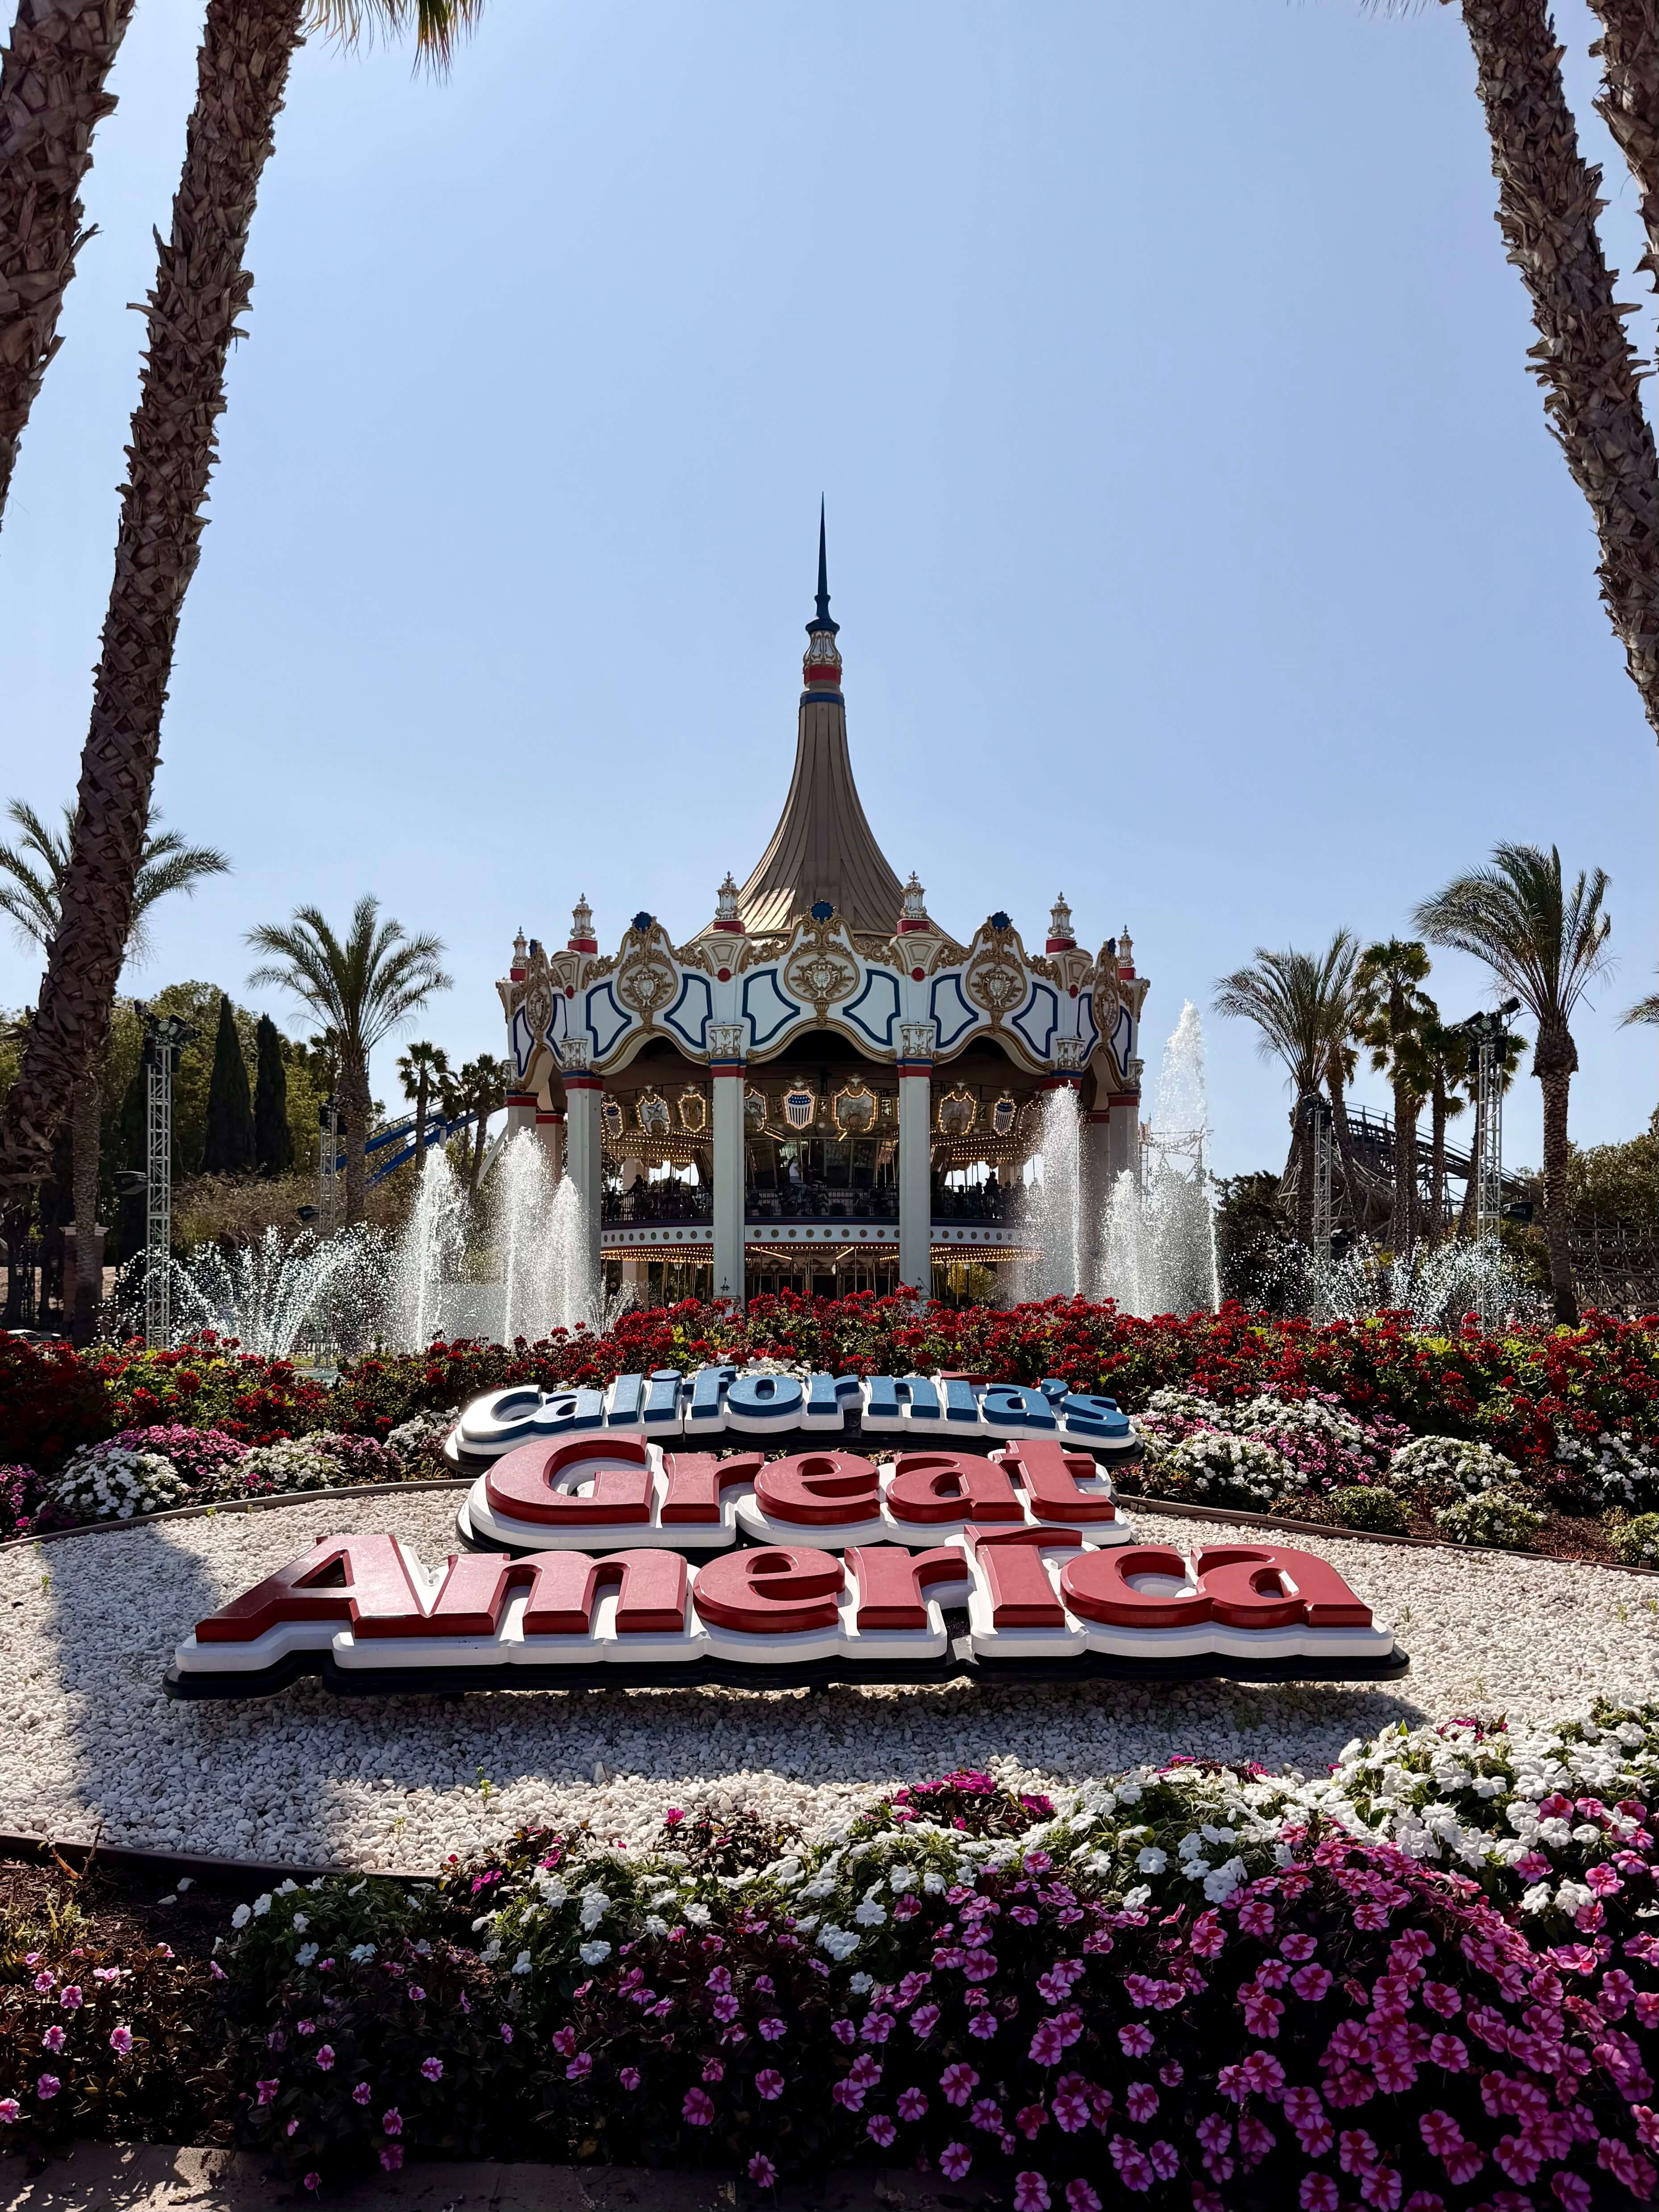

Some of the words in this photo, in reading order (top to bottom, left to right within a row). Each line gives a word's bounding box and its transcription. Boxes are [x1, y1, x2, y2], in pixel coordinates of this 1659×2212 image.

[462, 1365, 1130, 1443] California's
[485, 1433, 1116, 1525] Great
[195, 1525, 1373, 1643] America
